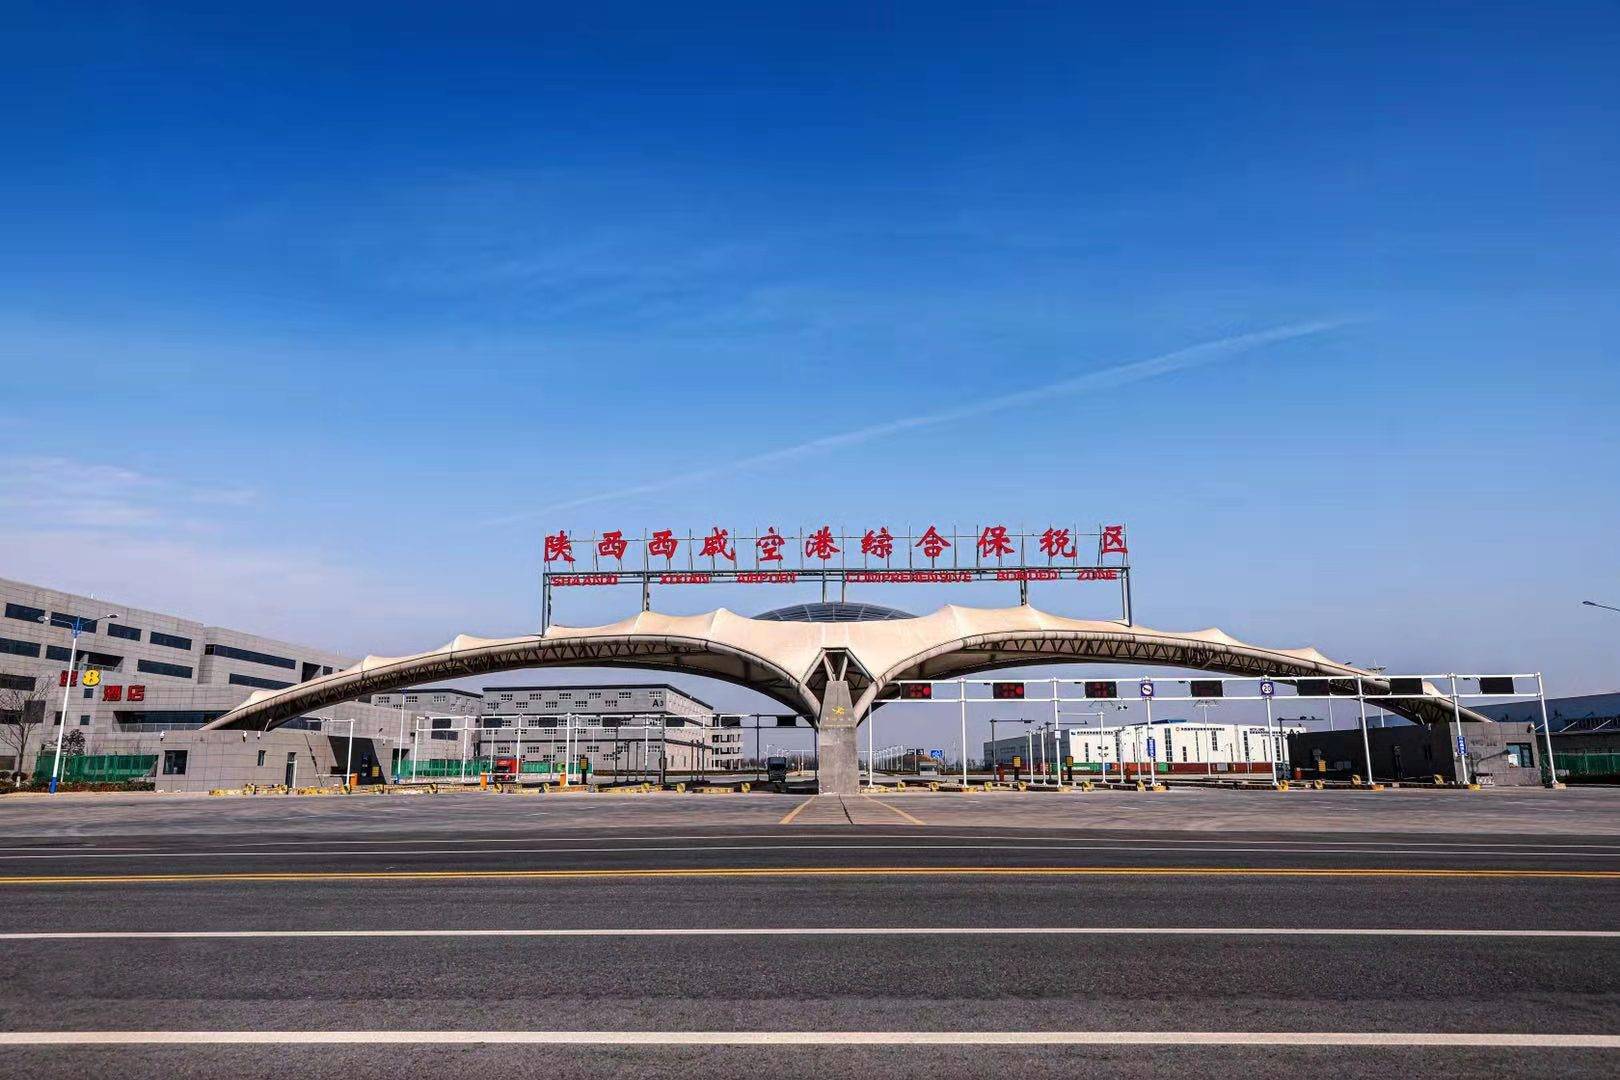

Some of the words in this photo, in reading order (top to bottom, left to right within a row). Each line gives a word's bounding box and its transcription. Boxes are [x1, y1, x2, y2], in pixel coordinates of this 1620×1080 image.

[544, 526, 1128, 562] 陕西西咸空港综合保税区
[1077, 569, 1117, 581] ZONE
[652, 699, 664, 707] A3
